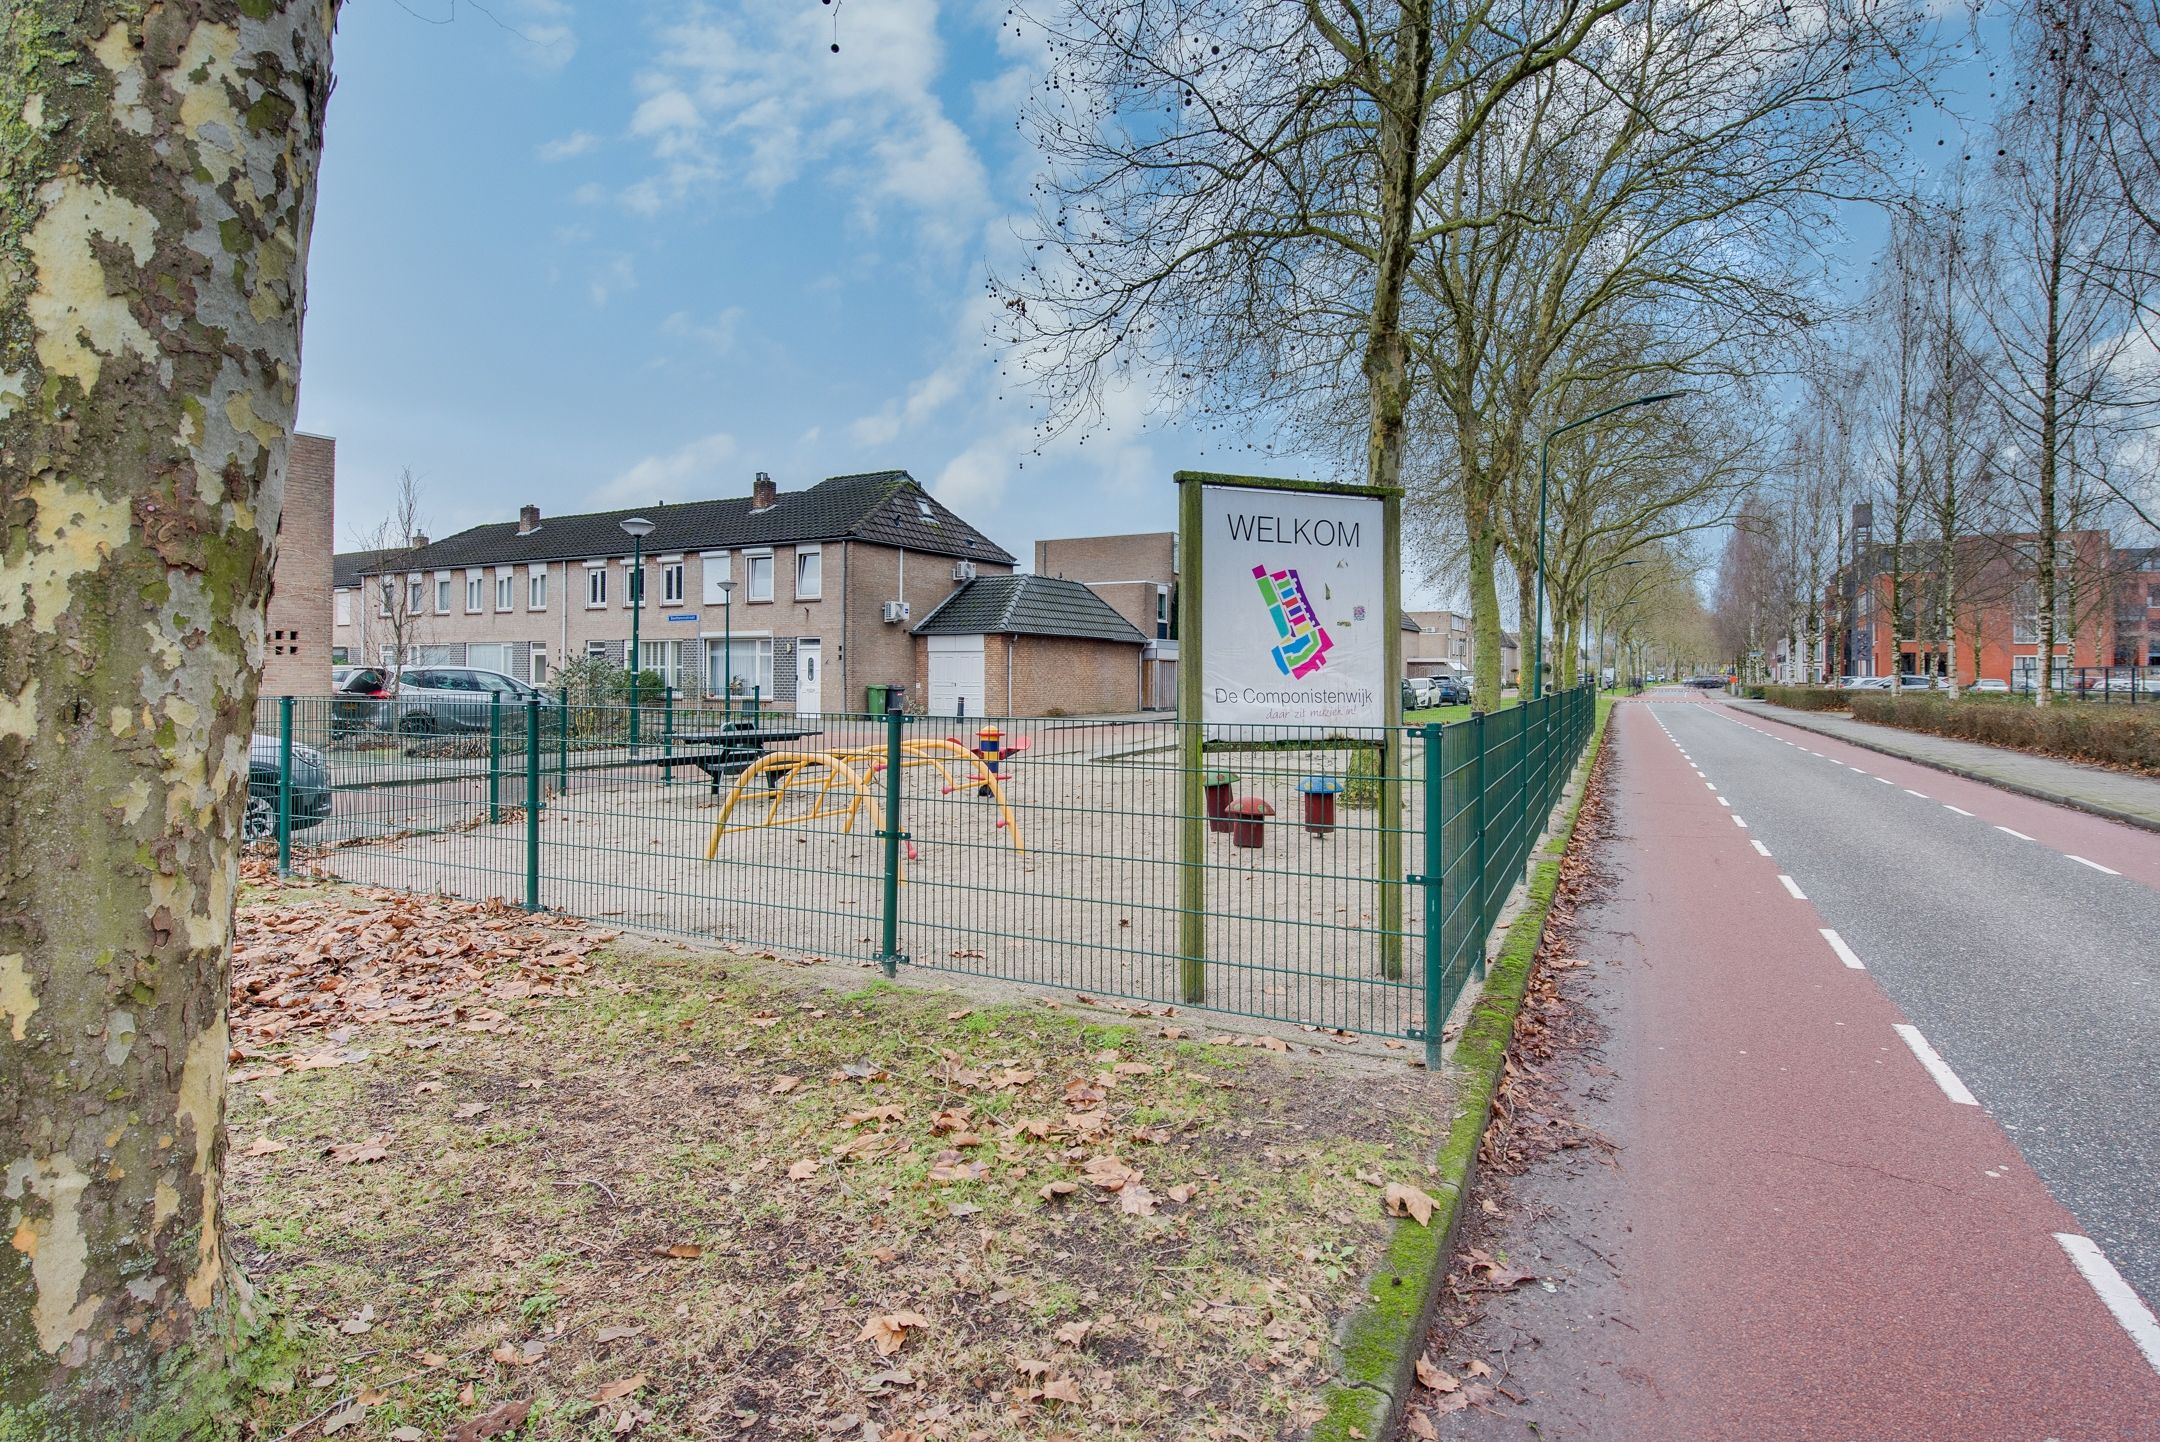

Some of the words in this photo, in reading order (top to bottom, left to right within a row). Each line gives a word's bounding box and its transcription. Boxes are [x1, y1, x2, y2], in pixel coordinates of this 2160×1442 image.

[1227, 514, 1359, 547] WELKOM
[1215, 688, 1238, 703] De
[1243, 688, 1373, 707] Componistenwijk
[1265, 709, 1290, 720] daar
[1294, 708, 1306, 718] zit
